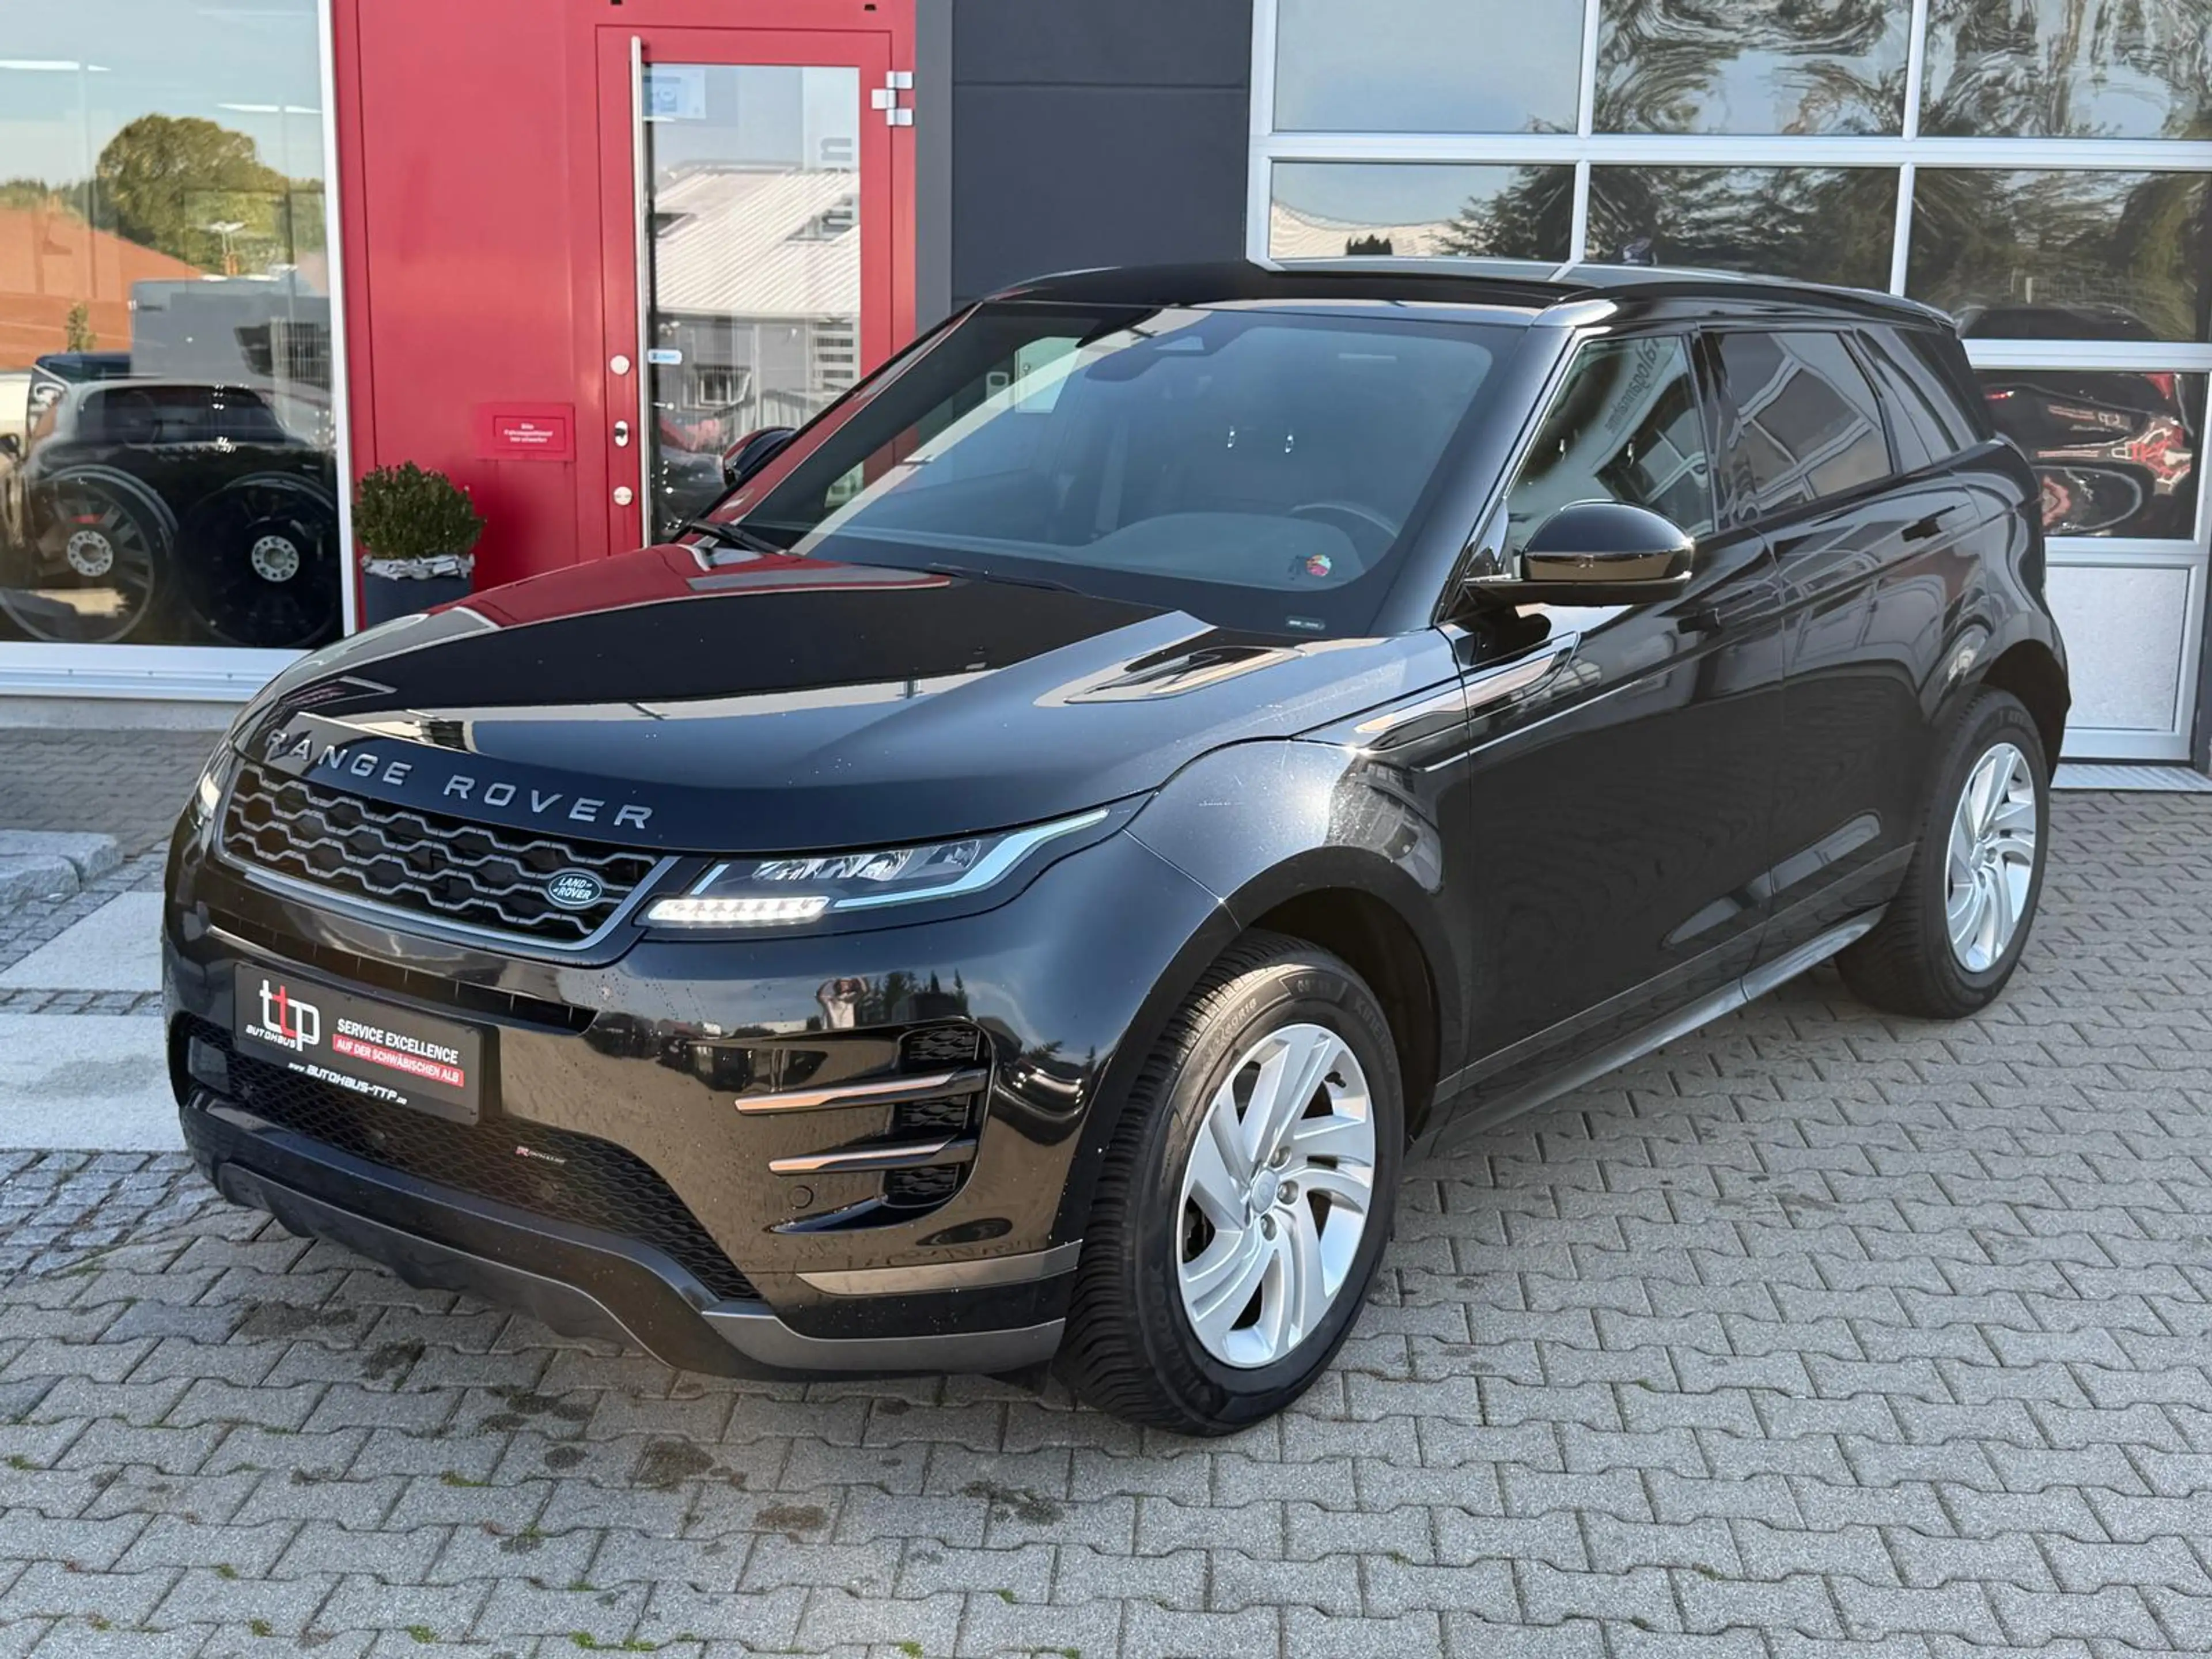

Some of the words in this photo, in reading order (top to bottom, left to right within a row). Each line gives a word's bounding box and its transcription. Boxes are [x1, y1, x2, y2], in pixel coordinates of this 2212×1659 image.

[264, 729, 412, 786] RANGE
[443, 774, 653, 830] ROVER
[259, 979, 320, 1051] ttp
[337, 1018, 384, 1044] SERVICE
[385, 1032, 459, 1065] EXCELLENCE
[336, 1039, 353, 1052] AUF
[354, 1044, 372, 1059] DER
[441, 1068, 460, 1083] ALB
